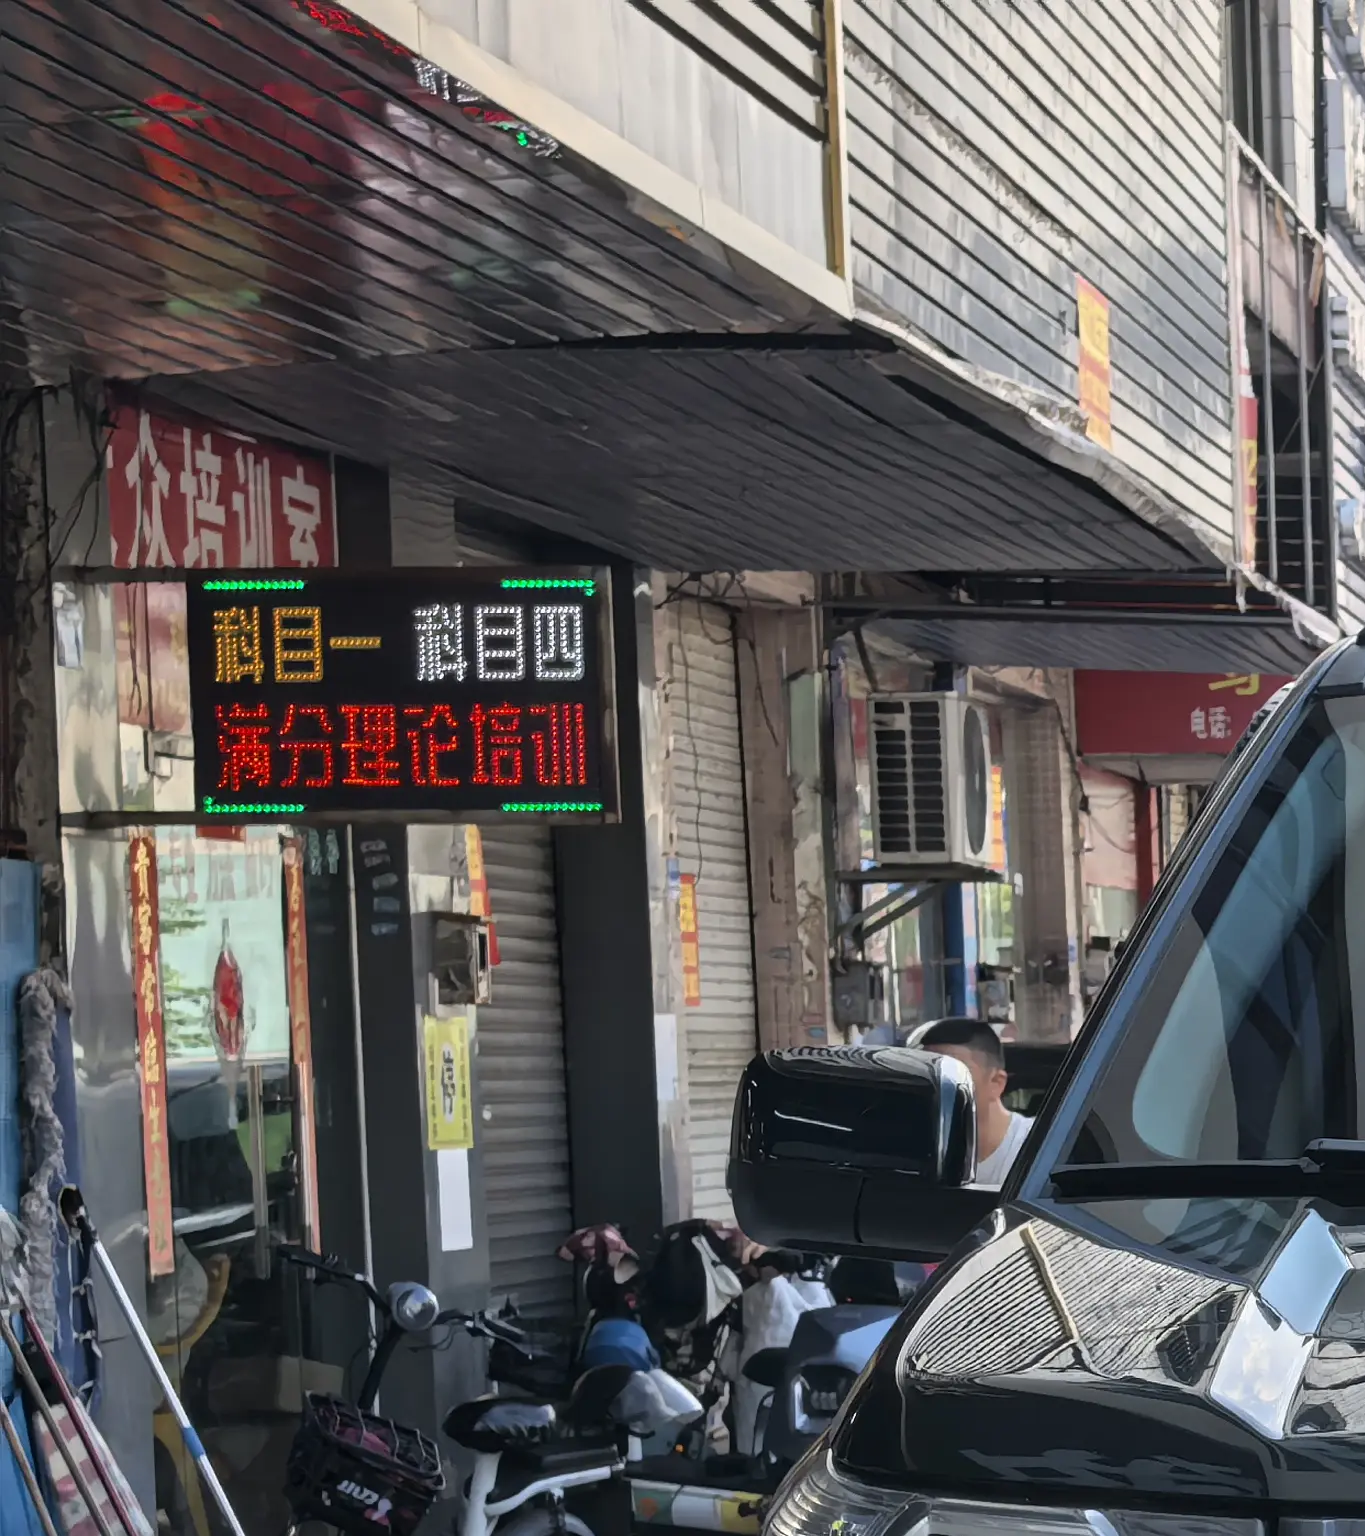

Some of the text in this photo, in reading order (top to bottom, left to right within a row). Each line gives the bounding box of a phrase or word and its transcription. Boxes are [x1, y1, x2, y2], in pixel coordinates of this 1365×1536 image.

[106, 408, 322, 568] 众培训室
[213, 602, 586, 683] 科目一 科目四
[214, 702, 588, 791] 满分理论培训
